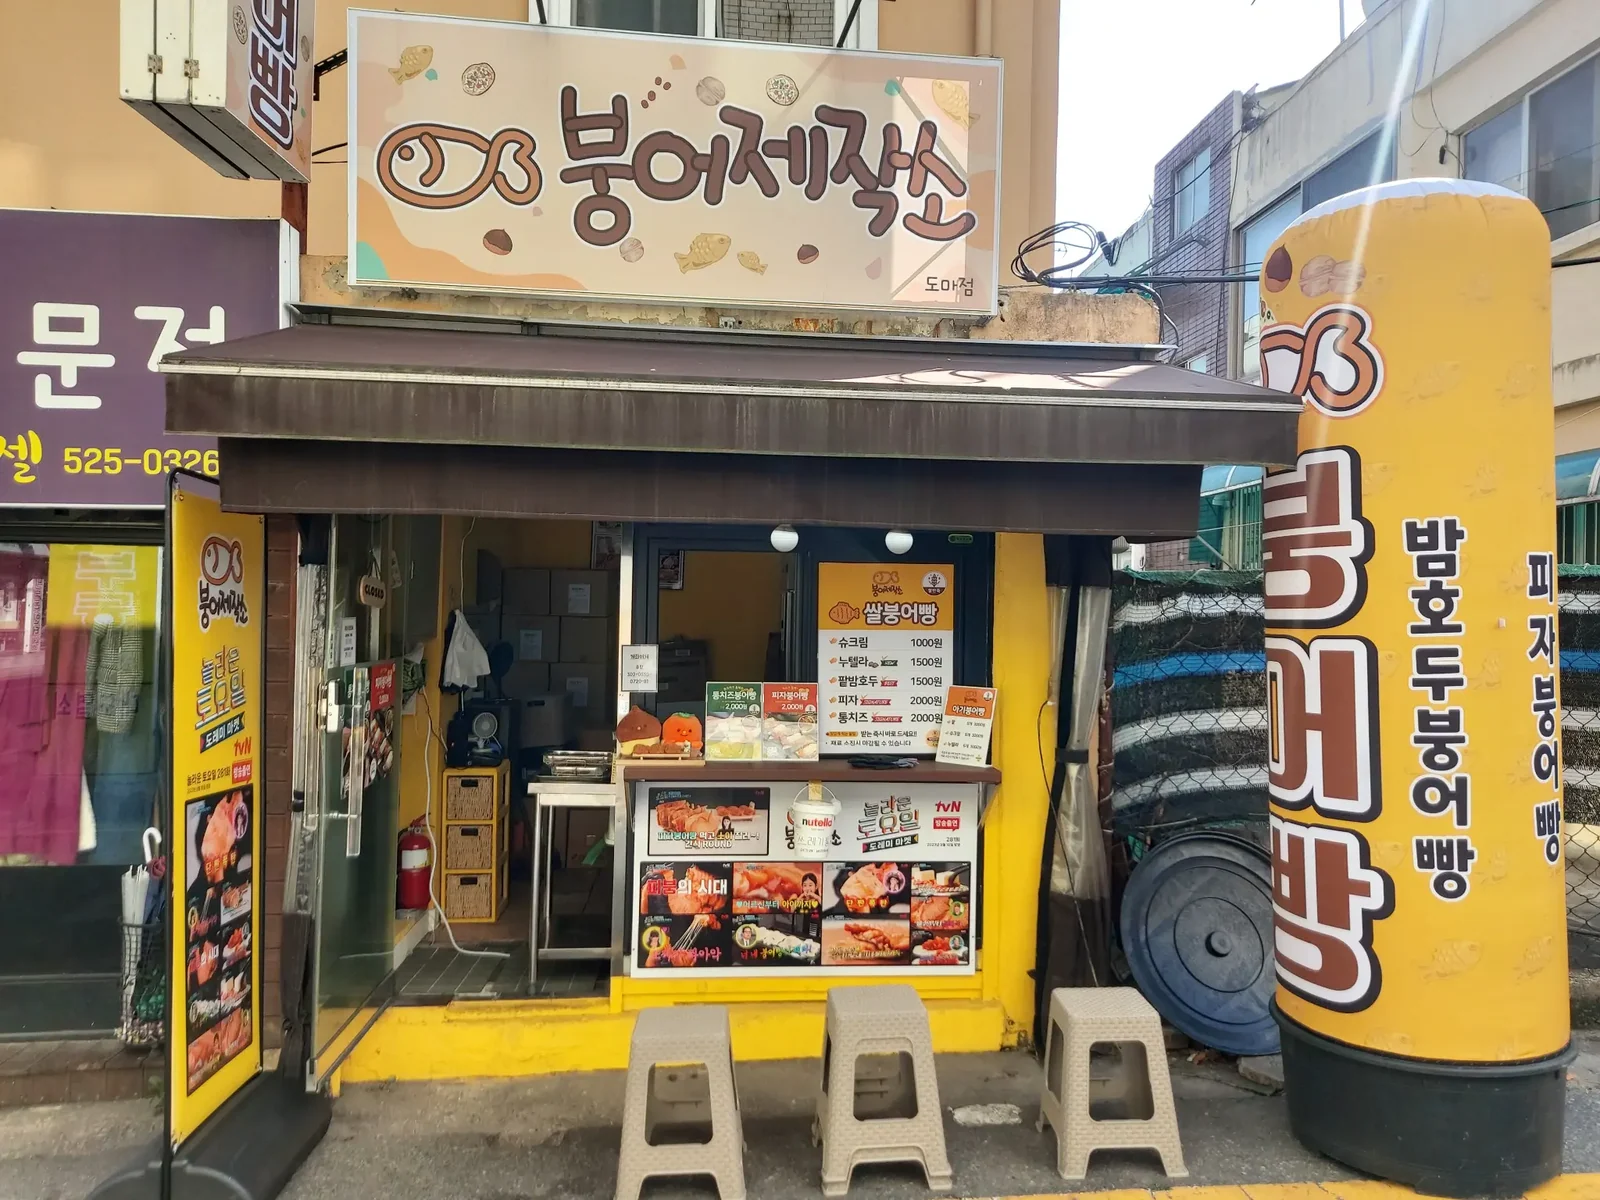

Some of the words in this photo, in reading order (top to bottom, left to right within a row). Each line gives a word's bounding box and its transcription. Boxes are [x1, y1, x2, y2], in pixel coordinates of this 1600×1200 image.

[560, 85, 977, 248] 붕어제작소
[925, 276, 975, 297] 도마점
[63, 447, 219, 476] 525-0326
[364, 584, 384, 600] CLOSED
[872, 583, 904, 598] 붕어제작소
[198, 579, 248, 630] 붕어제작소
[863, 601, 939, 626] 쌀붕어빵
[838, 636, 869, 649] 슈크림
[911, 638, 943, 649] 1000원
[838, 656, 869, 668] 누텔라
[911, 657, 943, 668] 1500원
[838, 675, 878, 687] 팥밤호두
[911, 676, 943, 687] 1500원
[712, 690, 756, 701] 통치즈붕어빵
[772, 690, 808, 701] 피자붕어빵
[838, 695, 858, 706] 피자
[910, 696, 942, 706] 2000원
[952, 704, 986, 717] 아기붕어빵
[838, 712, 868, 724] 통치즈
[911, 713, 943, 724] 2000원
[205, 726, 226, 748] 도레미
[227, 718, 240, 735] 마켓
[234, 736, 252, 757] tvN
[202, 768, 217, 782] 토요일
[935, 800, 962, 813] tvN
[802, 817, 833, 827] nutella
[934, 819, 959, 828] 방송출연
[699, 831, 715, 841] 먹고
[702, 840, 732, 848] ROUND
[869, 840, 894, 851] 도레미
[895, 836, 912, 846] 마켓
[698, 879, 728, 896] 시대
